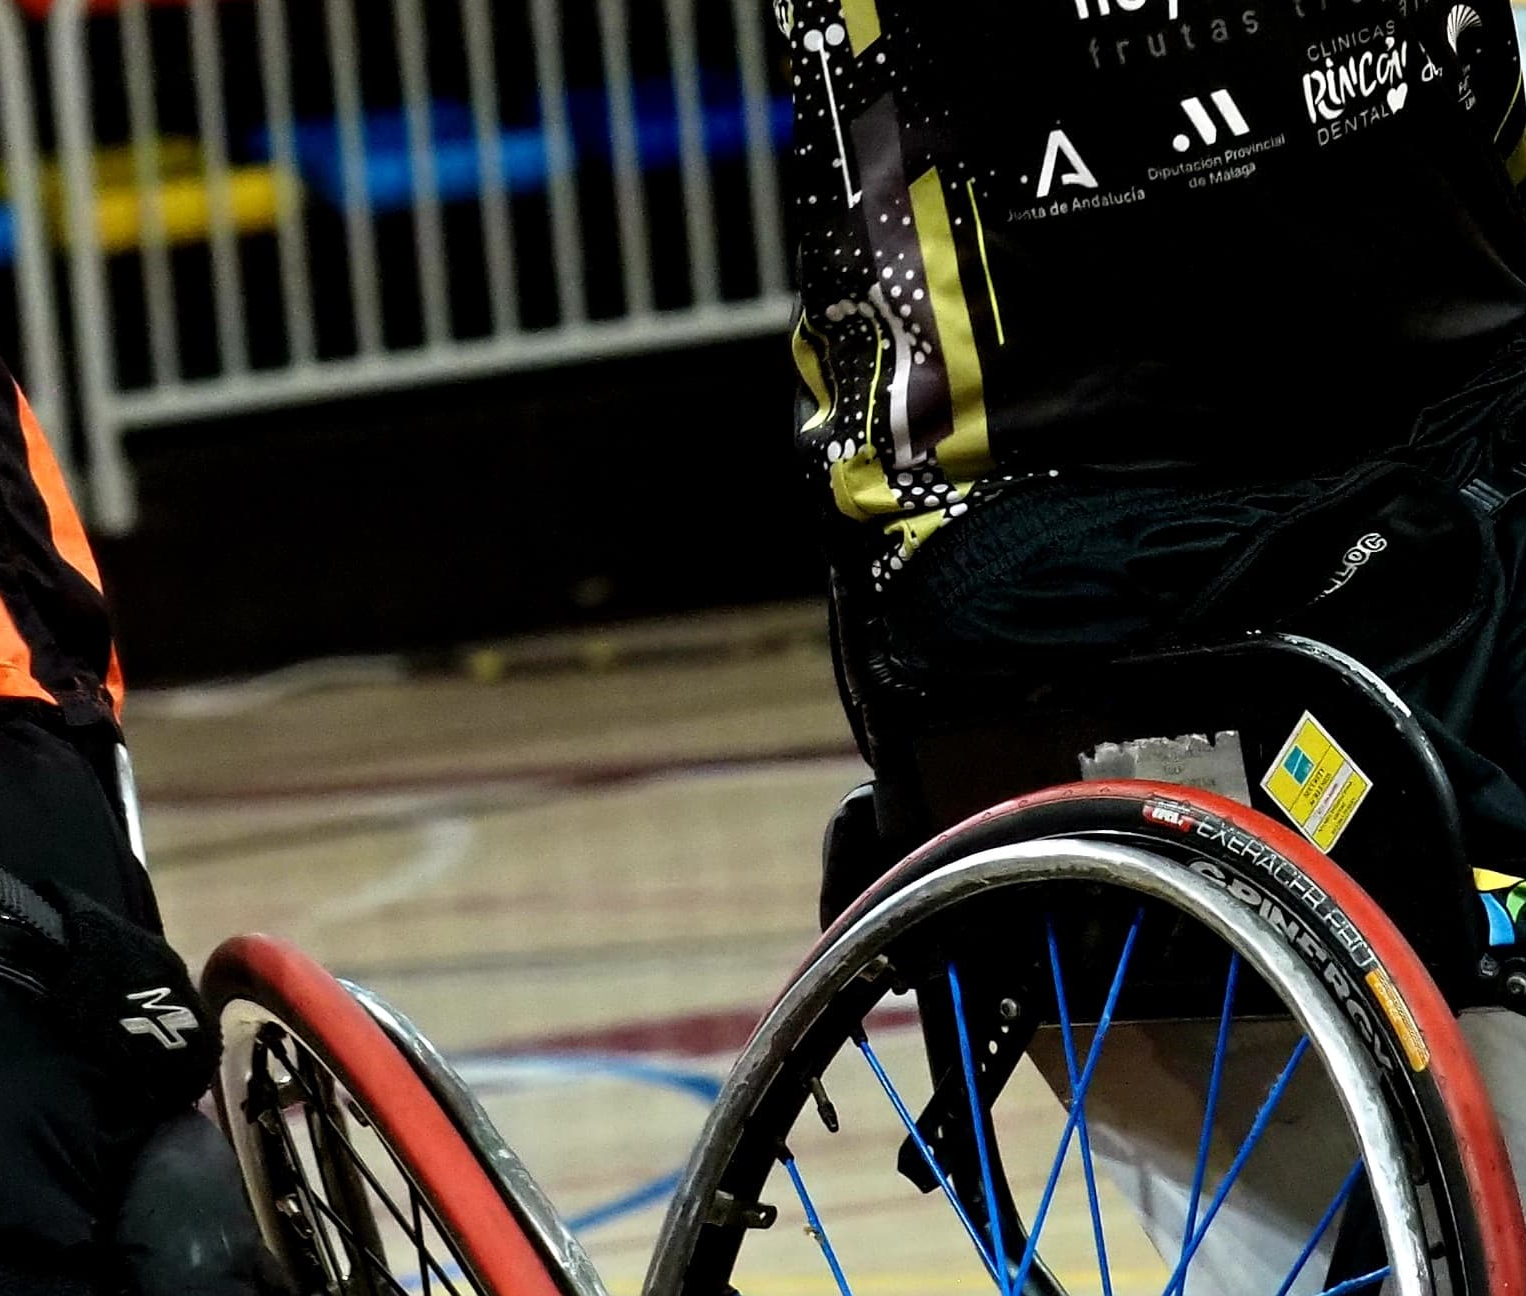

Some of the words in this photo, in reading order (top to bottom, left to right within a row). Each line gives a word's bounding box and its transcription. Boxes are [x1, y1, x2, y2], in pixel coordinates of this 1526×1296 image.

[1317, 105, 1391, 147] DENTAL
[1050, 200, 1069, 217] de
[1072, 185, 1146, 212] Andalucía
